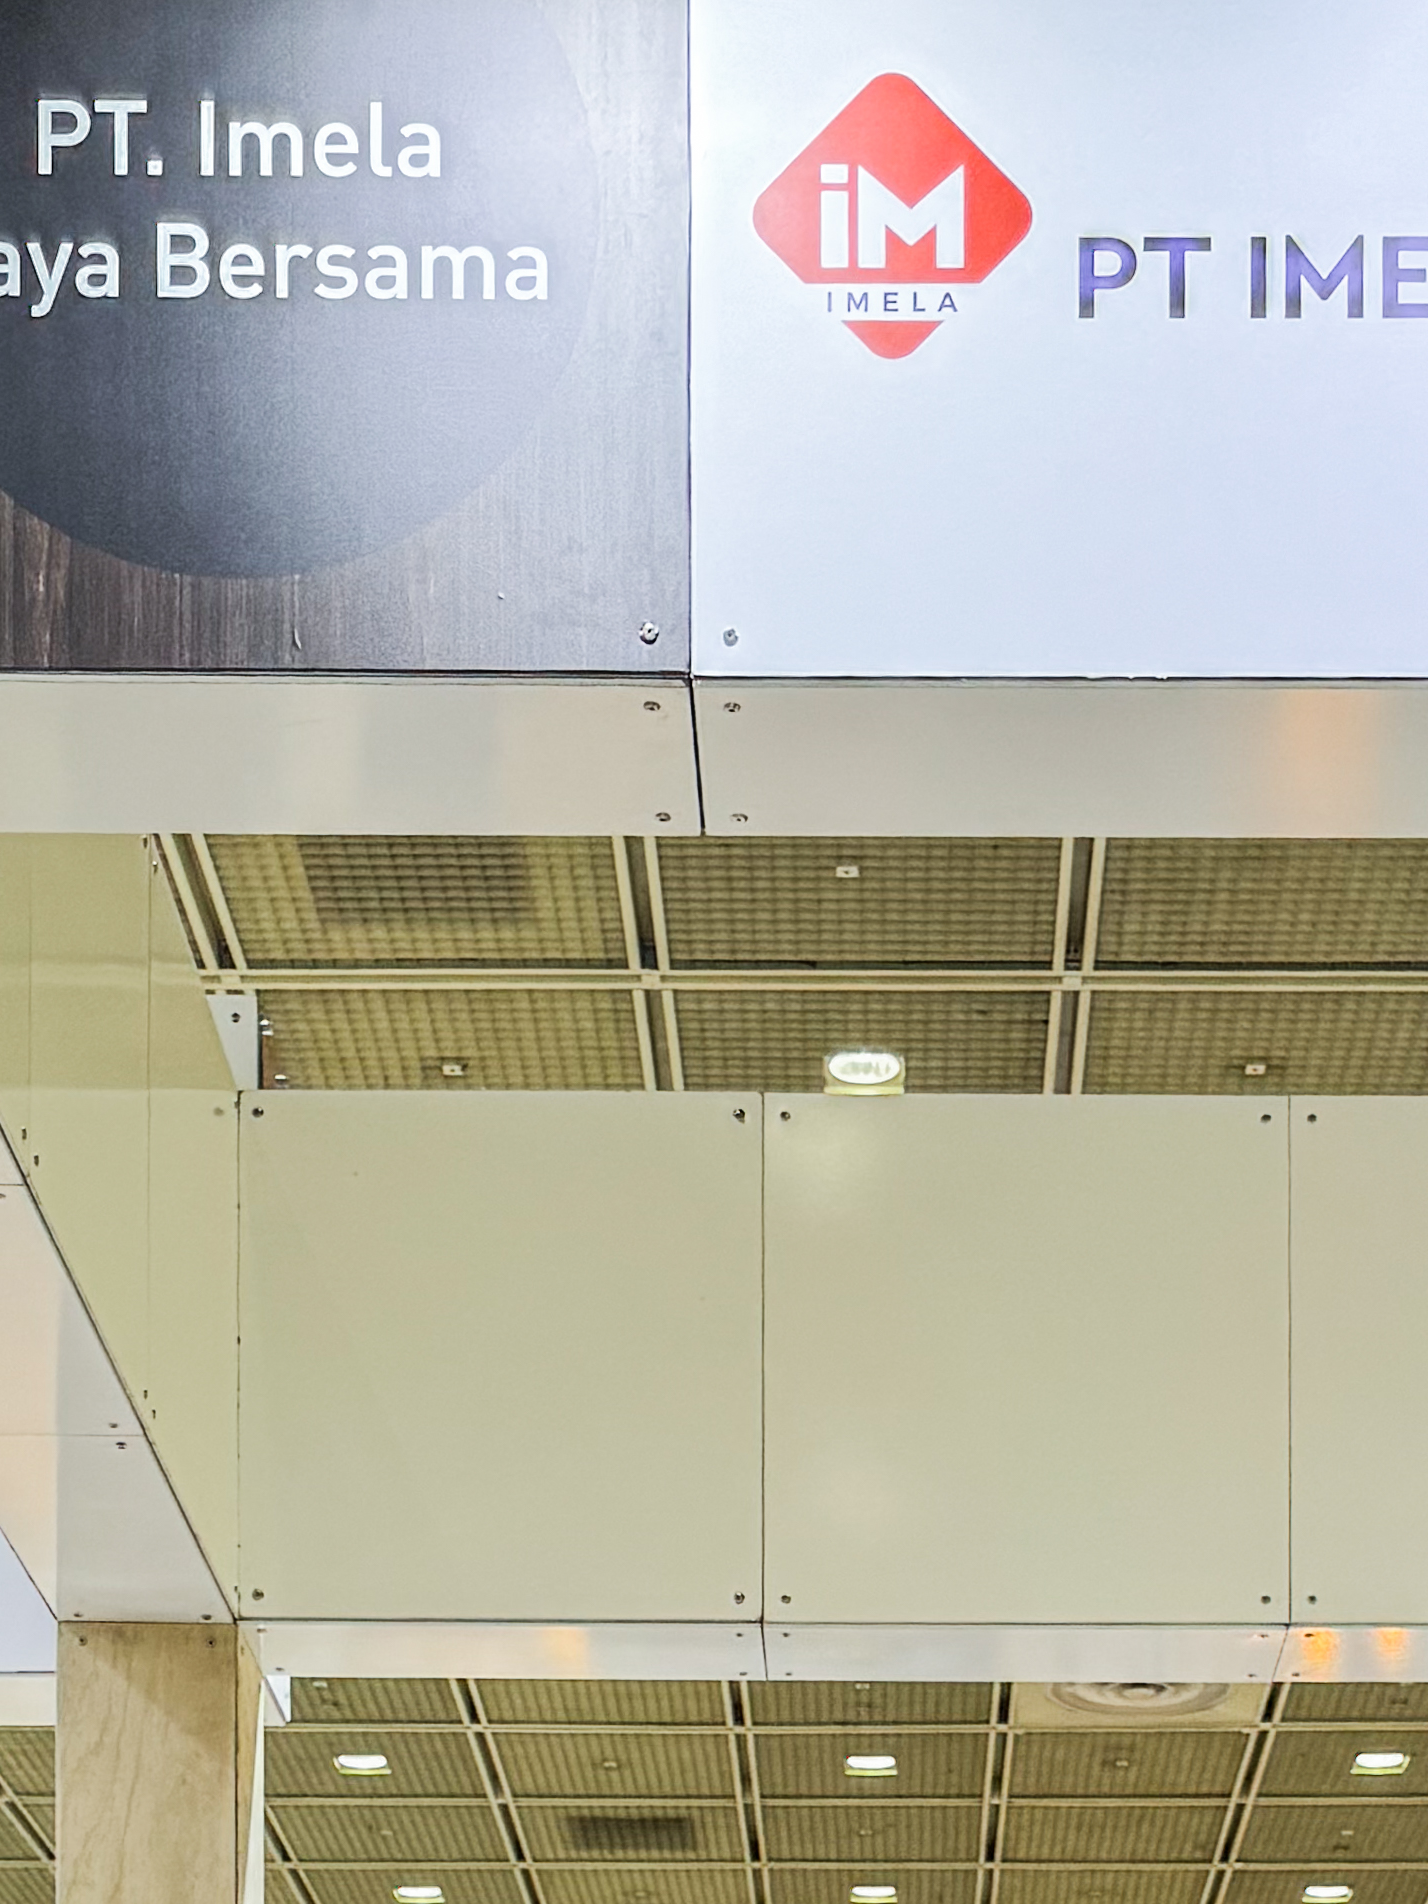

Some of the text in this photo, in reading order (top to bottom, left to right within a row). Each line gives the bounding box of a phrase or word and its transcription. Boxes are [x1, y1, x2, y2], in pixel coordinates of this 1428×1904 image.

[36, 98, 443, 179] PT. Imela
[155, 222, 551, 303] Bersama
[825, 290, 959, 314] IMELA
[1076, 234, 1210, 320] PT
